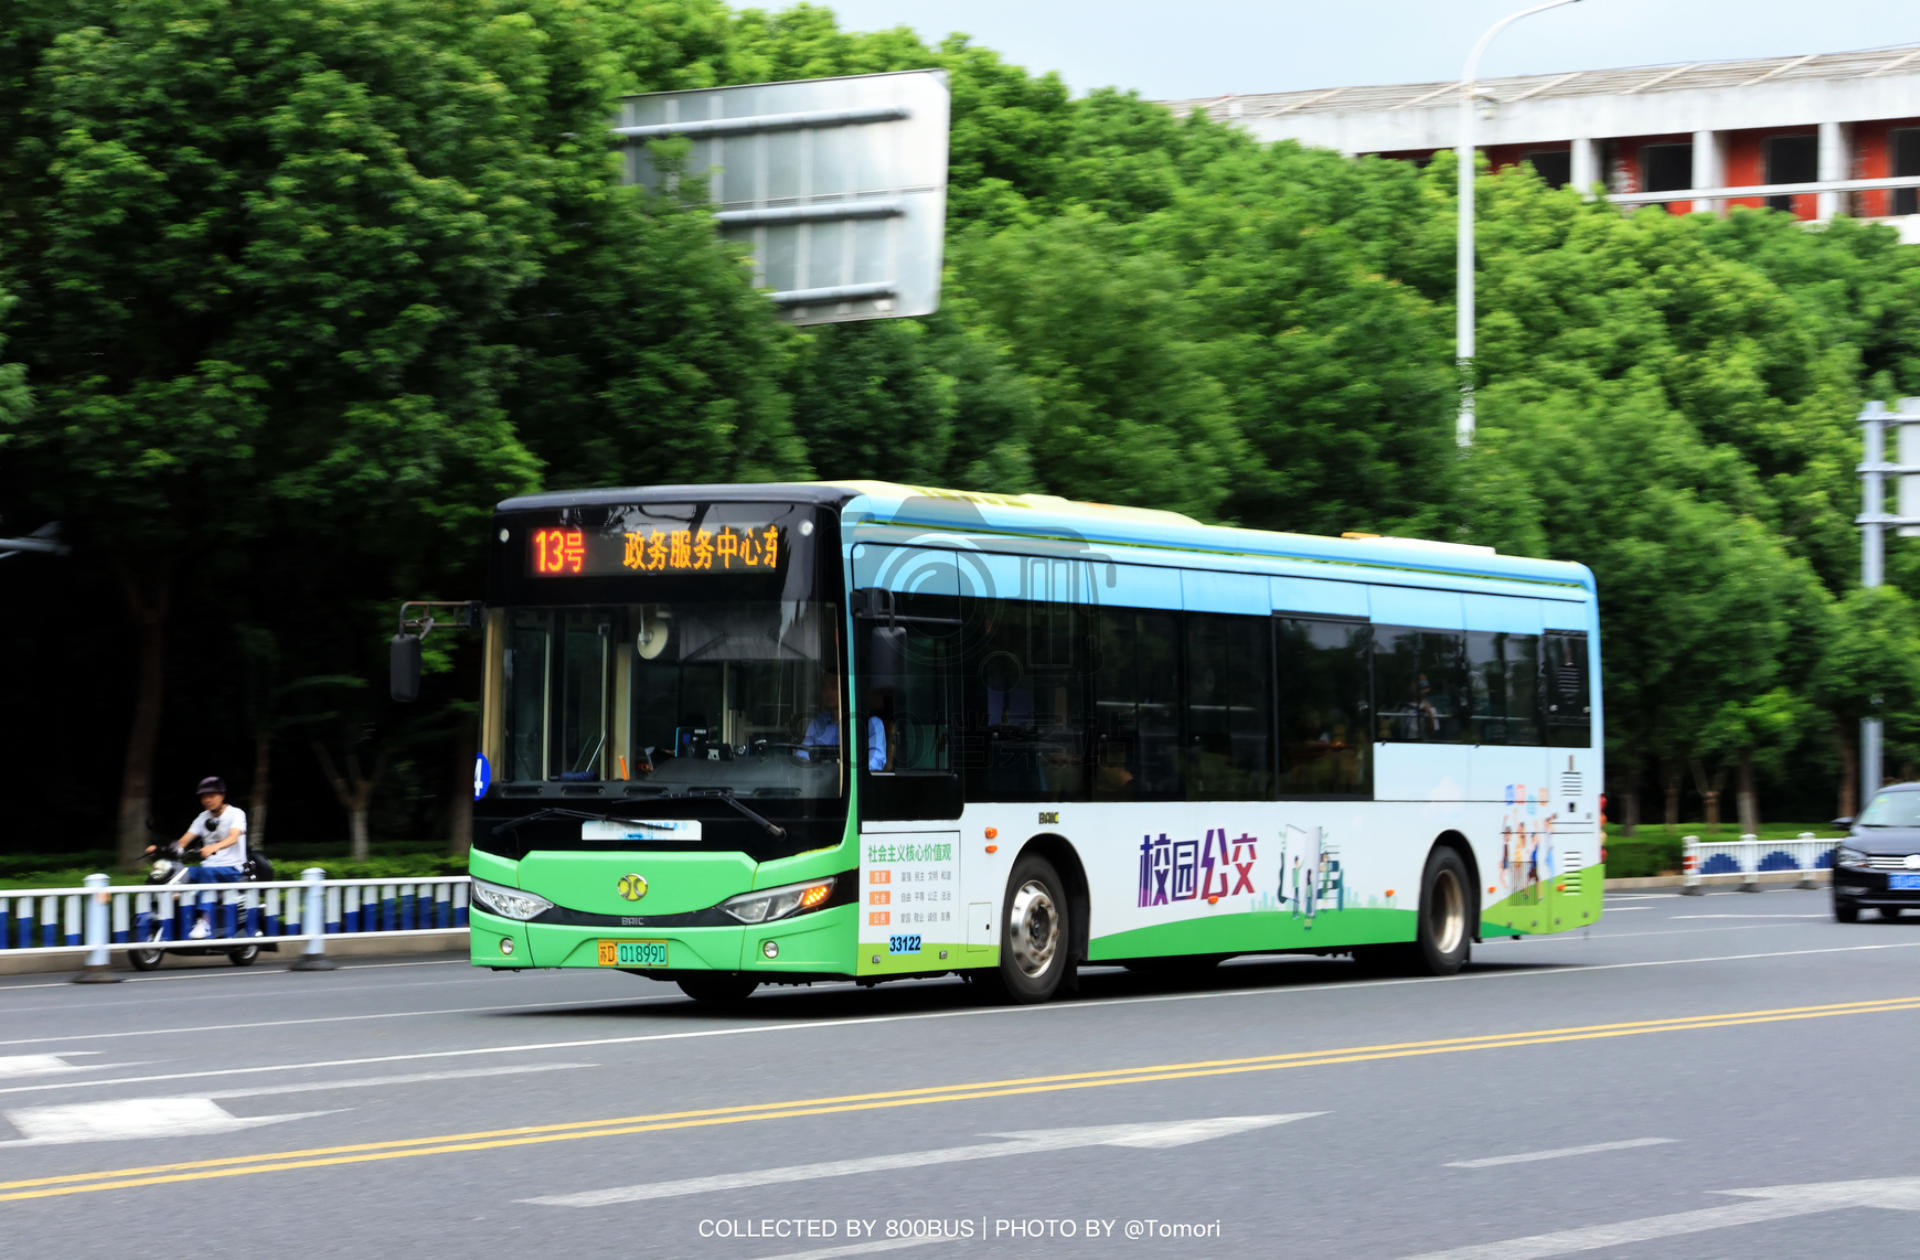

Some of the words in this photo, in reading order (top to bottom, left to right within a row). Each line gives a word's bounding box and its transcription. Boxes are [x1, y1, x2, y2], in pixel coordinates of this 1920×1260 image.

[534, 529, 585, 573] 13号
[1038, 811, 1059, 824] BAIC
[868, 843, 952, 863] 社会主义核心价值观
[1138, 828, 1258, 908] 校园公交
[621, 916, 645, 926] BAIC
[889, 935, 921, 952] 33122
